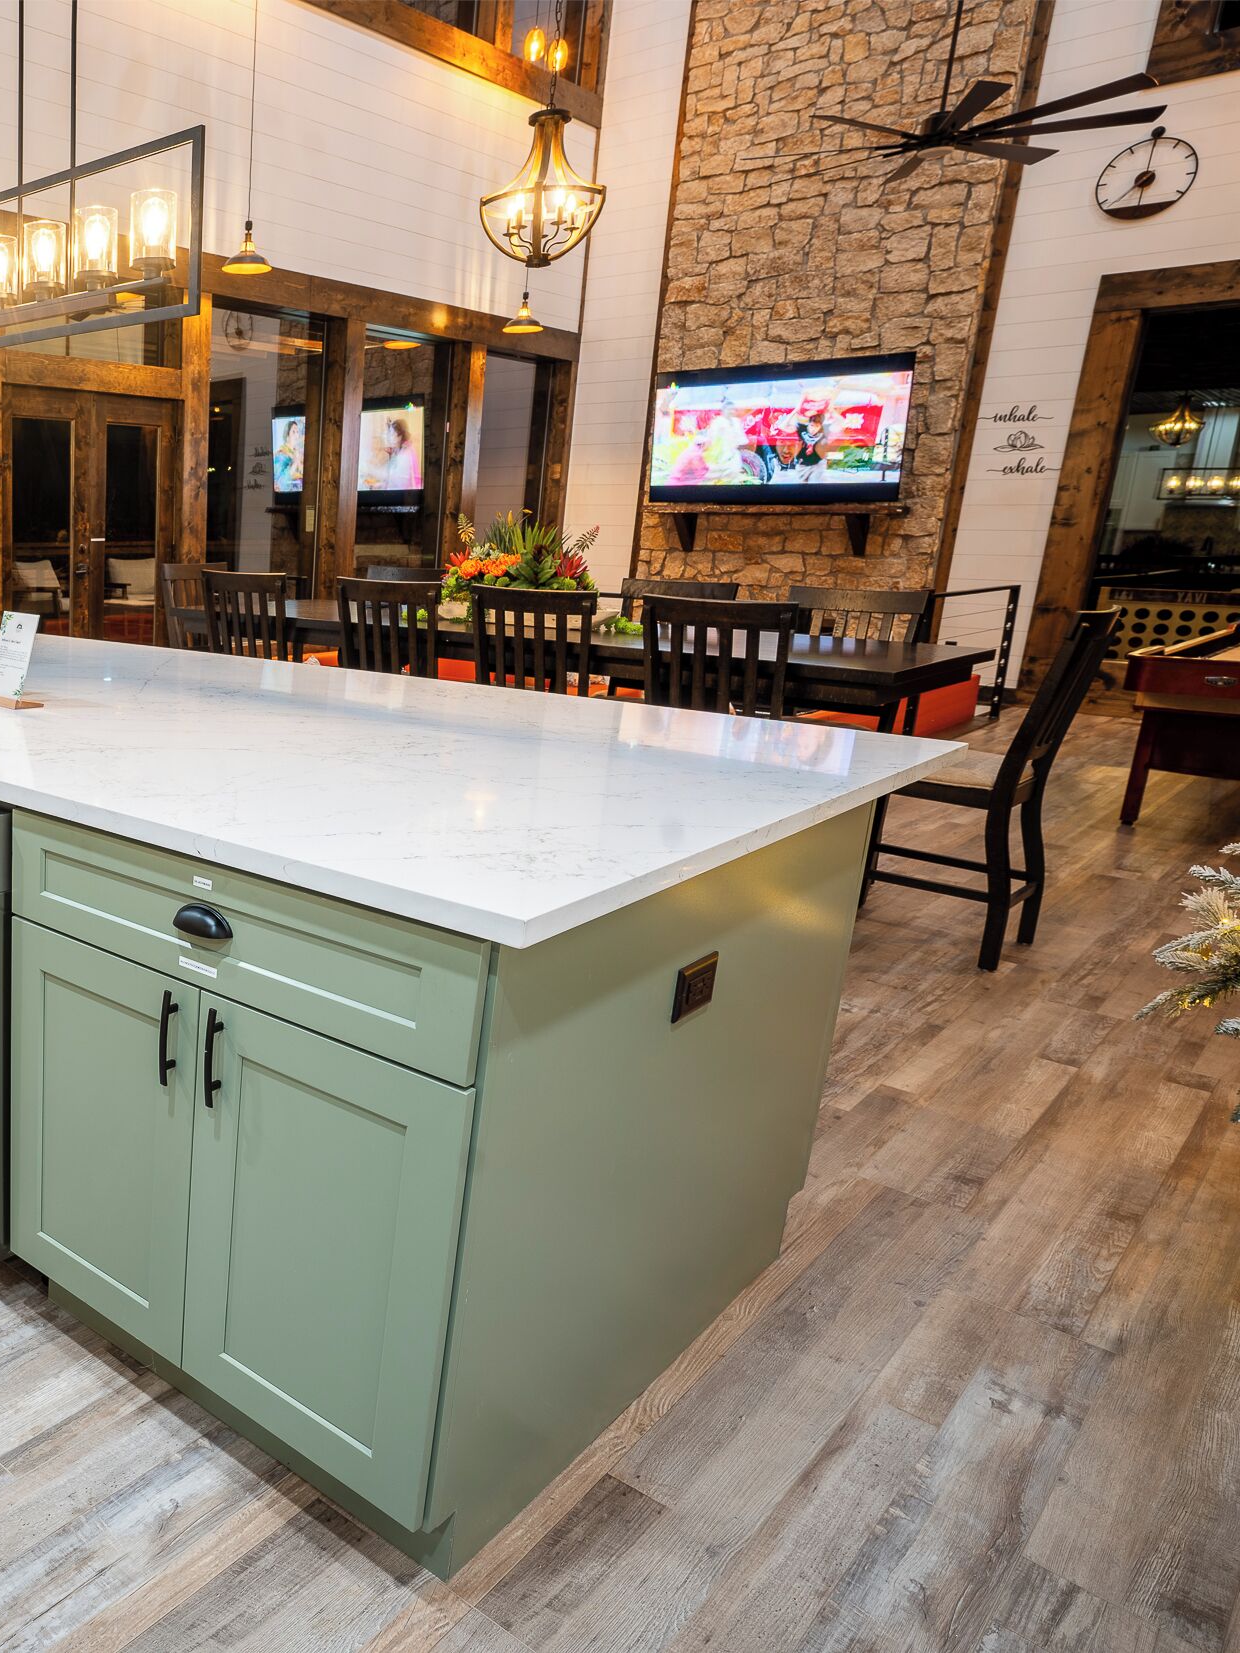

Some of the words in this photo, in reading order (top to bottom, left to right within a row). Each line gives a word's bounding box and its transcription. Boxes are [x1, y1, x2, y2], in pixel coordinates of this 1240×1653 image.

[977, 404, 1055, 423] inhale
[986, 456, 1062, 475] exhale
[1177, 591, 1208, 604] YAVI
